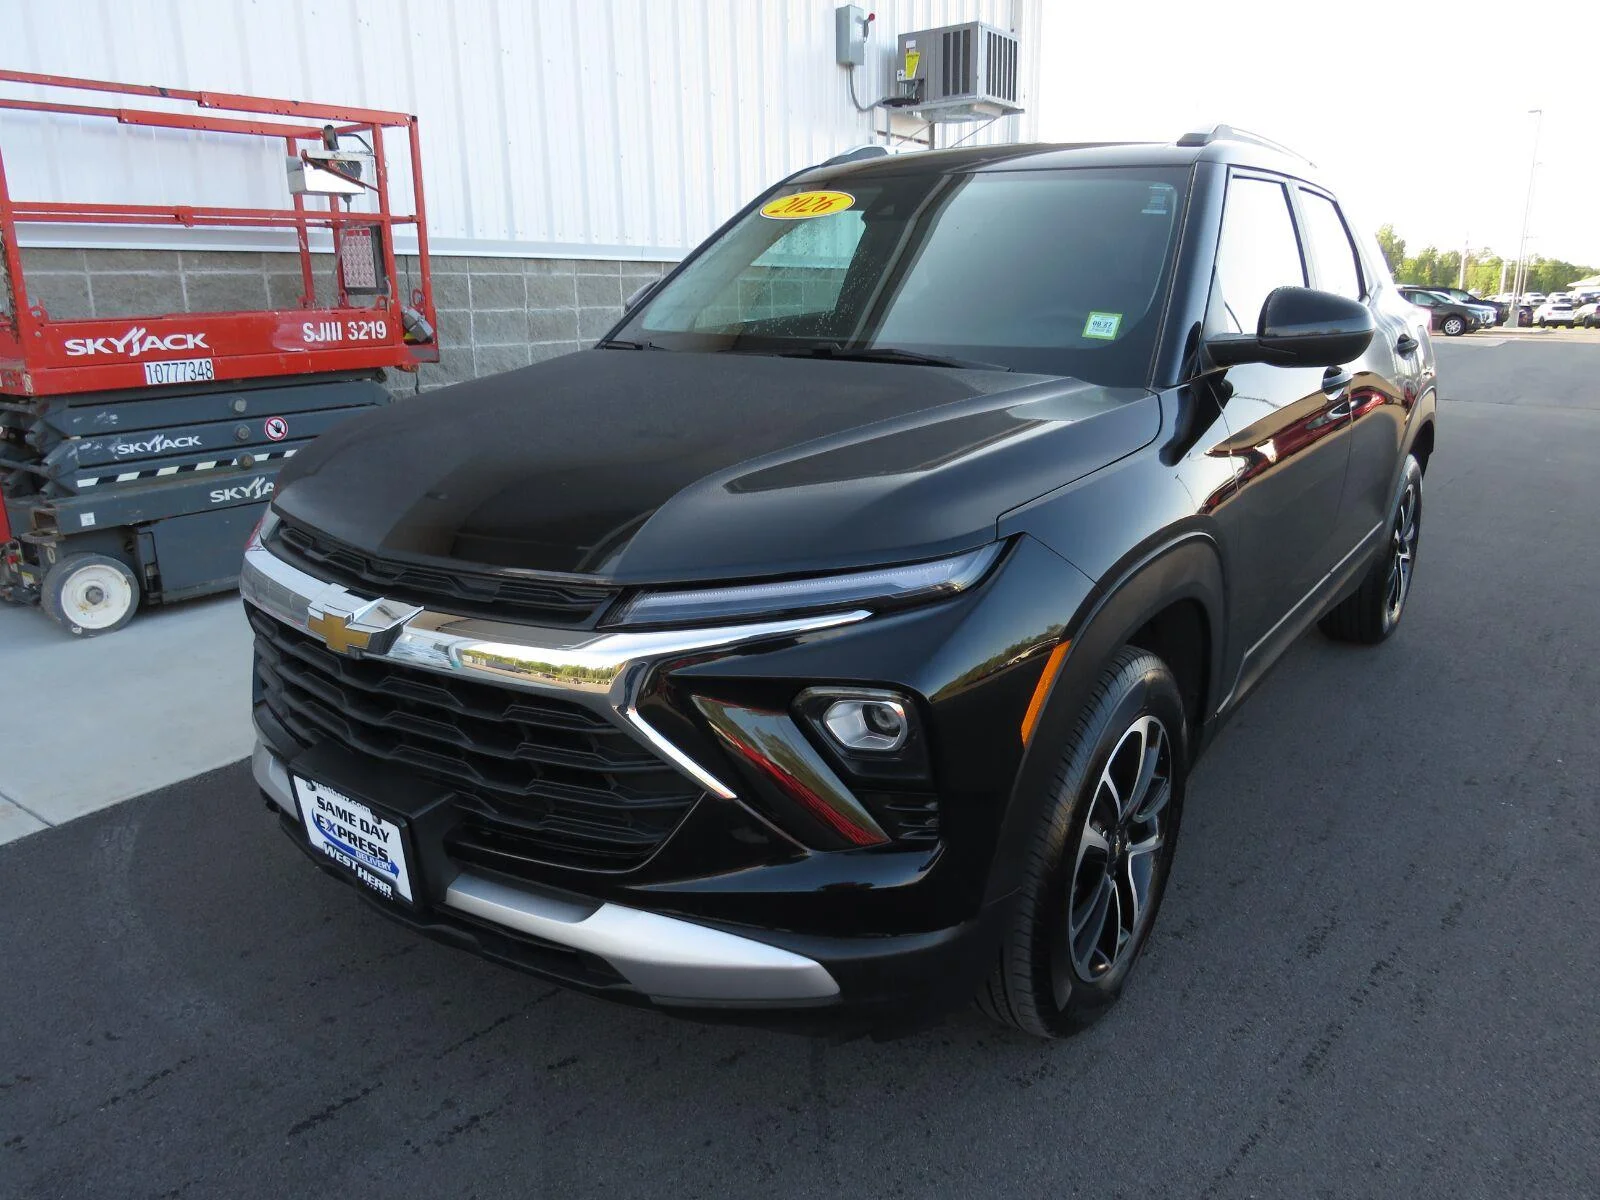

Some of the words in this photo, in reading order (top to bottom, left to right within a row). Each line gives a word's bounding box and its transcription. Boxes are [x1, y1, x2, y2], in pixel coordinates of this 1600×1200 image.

[768, 195, 845, 215] 2026
[64, 326, 210, 357] SKYJACK
[347, 320, 387, 340] 3219
[146, 360, 213, 384] 10777348
[116, 434, 202, 455] SKYJACK
[209, 476, 275, 503] SKYJA
[316, 795, 356, 828] SAME
[359, 818, 389, 844] DAY
[315, 813, 389, 862] EXPRESS
[322, 842, 359, 871] WEST
[357, 866, 392, 896] HERR
[355, 851, 392, 872] DELIVERY
